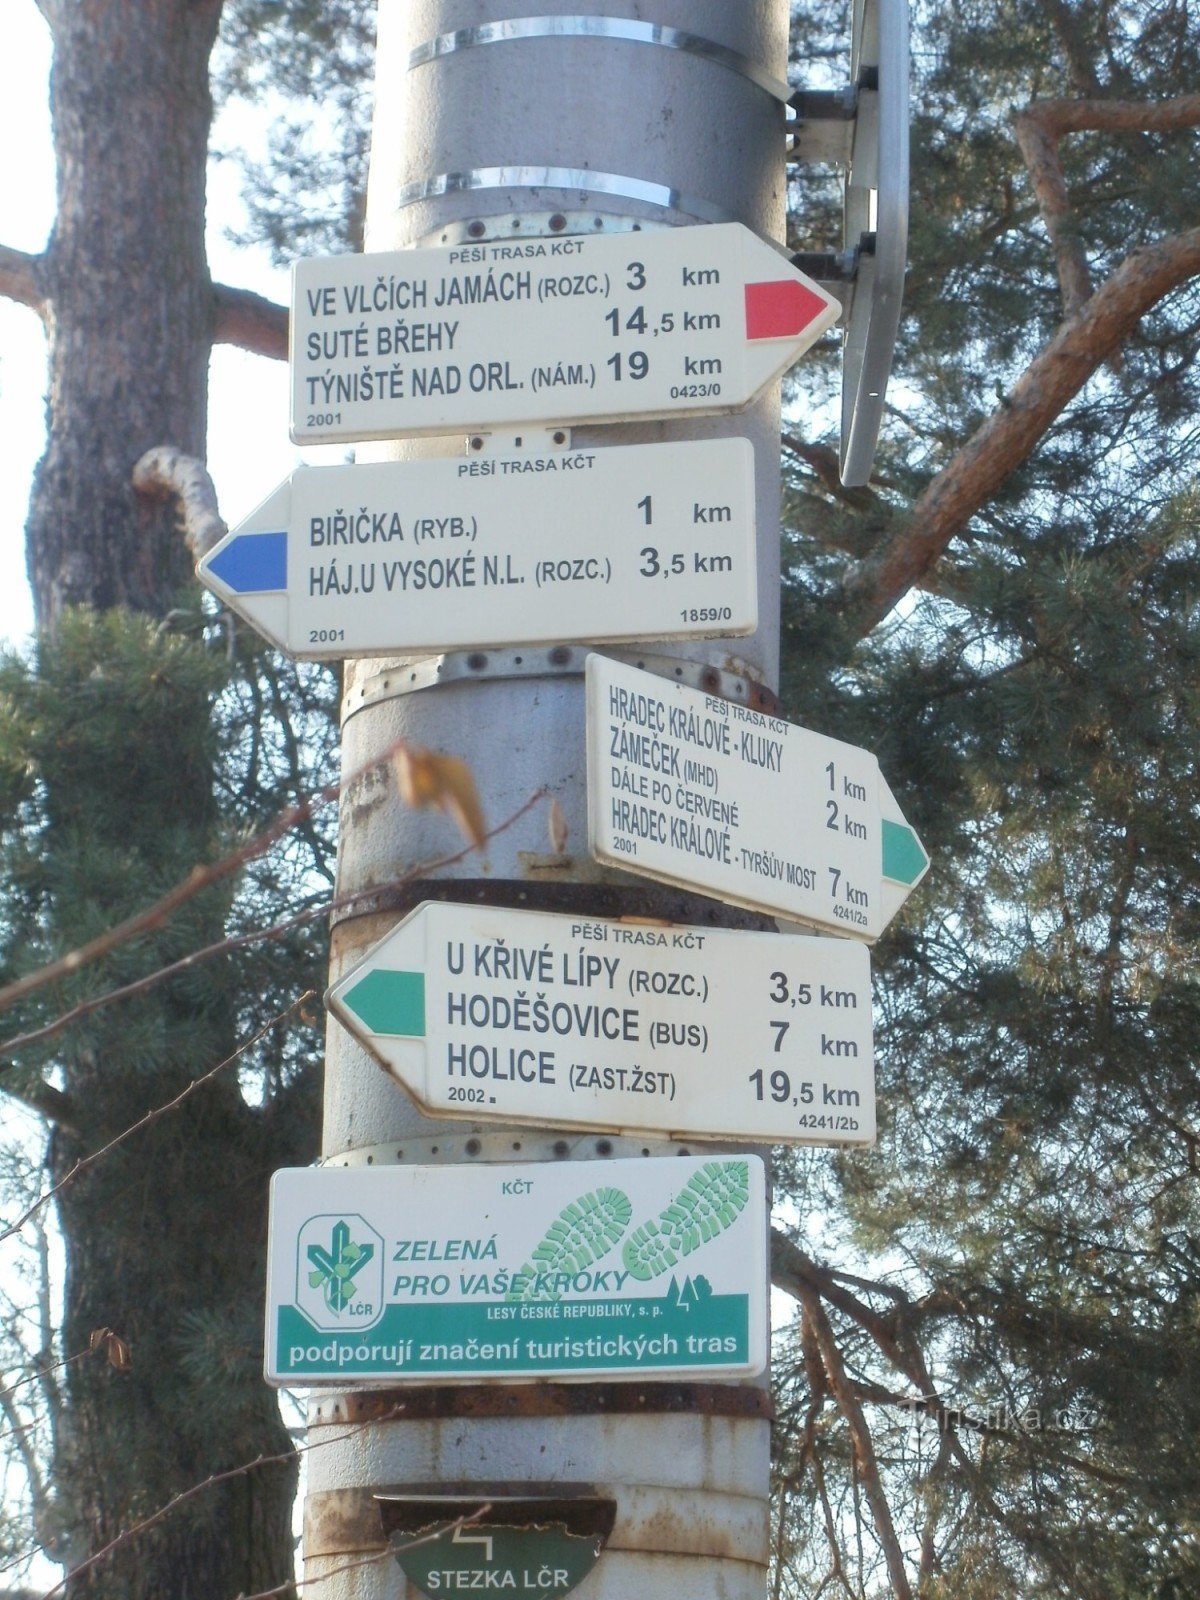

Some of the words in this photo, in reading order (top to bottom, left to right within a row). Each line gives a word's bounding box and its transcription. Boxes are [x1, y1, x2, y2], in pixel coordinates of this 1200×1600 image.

[449, 245, 486, 264] PĚŠÍ
[491, 244, 547, 261] TRASA
[550, 240, 584, 258] KČT
[307, 287, 337, 317] VE
[344, 275, 427, 314] VLČÍCH
[434, 266, 531, 309] JAMÁCH
[538, 273, 611, 301] (ROZC.)
[626, 262, 647, 291] 3
[682, 267, 720, 286] km
[307, 325, 368, 361] SUTÉ
[377, 321, 459, 355] BŘEHY
[605, 306, 674, 337] 14,5
[683, 311, 720, 332] km
[306, 367, 403, 405] TÝNIŠTĚ
[411, 365, 461, 398] NAD
[469, 360, 524, 393] ORL.
[531, 364, 596, 393] (NÁM.)
[607, 351, 649, 382] 19
[684, 356, 722, 376] km
[670, 383, 721, 400] 0423/0
[306, 413, 342, 428] 2001
[458, 458, 495, 478] PĚŠÍ
[500, 458, 557, 475] TRASA
[561, 455, 596, 472] KČT
[310, 506, 403, 547] BIŘIČKA
[413, 516, 478, 545] (RYB.)
[637, 495, 653, 525] 1
[693, 503, 731, 523] km
[382, 550, 476, 592] VYSOKÉ
[483, 554, 525, 586] N.L.
[535, 557, 611, 588] (ROZC.)
[639, 547, 685, 579] 3,5
[694, 552, 733, 573] km
[680, 606, 732, 623] 1859/0
[309, 629, 345, 643] 2001
[705, 696, 729, 716] PĚŠÍ
[732, 705, 766, 728] TRASA
[609, 685, 665, 733] HRADEC
[669, 704, 731, 756] KRÁLOVÉ
[741, 730, 783, 773] KLUKY
[826, 761, 835, 791] 1
[844, 776, 866, 802] km
[610, 725, 680, 780] ZÁMEČEK
[684, 758, 718, 794] (MHD)
[826, 800, 839, 830] 2
[845, 814, 867, 840] km
[612, 766, 648, 800] DÁLE
[653, 780, 672, 805] PO
[675, 781, 739, 827] ČERVENÉ
[612, 797, 666, 845] HRADEC
[670, 816, 731, 865] KRÁLOVÉ
[740, 848, 783, 882] TYRŠŮV
[786, 865, 816, 891] MOST
[829, 867, 841, 897] 7
[846, 882, 868, 907] km
[613, 836, 638, 855] 2001
[833, 904, 868, 926] 4241/2a
[571, 923, 608, 940] PĚŠÍ
[612, 929, 668, 947] TRASA
[671, 930, 705, 950] KČT
[447, 941, 465, 975] U
[474, 937, 554, 984] KŘIVÉ
[562, 950, 620, 990] LÍPY
[628, 969, 709, 1003] (ROZC.)
[769, 972, 812, 1006] 3,5
[820, 985, 857, 1009] km
[447, 992, 640, 1042] HODĚŠOVICE
[649, 1021, 709, 1054] (BUS)
[769, 1020, 790, 1053] 7
[821, 1034, 858, 1057] km
[447, 1042, 556, 1085] HOLICE
[569, 1064, 676, 1101] (ZAST.ŽST)
[748, 1069, 814, 1106] 19,5
[822, 1083, 860, 1106] km
[448, 1087, 485, 1103] 2002
[799, 1114, 859, 1131] 4241/2b
[502, 1180, 534, 1195] KČT
[393, 1233, 499, 1262] ZELENÁ
[393, 1274, 450, 1296] PRO
[459, 1267, 526, 1294] VAŠE
[533, 1270, 629, 1293] KROKY
[349, 1301, 373, 1316] LČR
[487, 1307, 517, 1319] LESY
[520, 1302, 560, 1318] ČESKÉ
[289, 1340, 413, 1368] podporují
[420, 1337, 519, 1360] značení
[526, 1334, 678, 1359] turistických
[686, 1334, 737, 1354] tras
[427, 1569, 516, 1589] STEZKA
[524, 1565, 569, 1588] LČR
